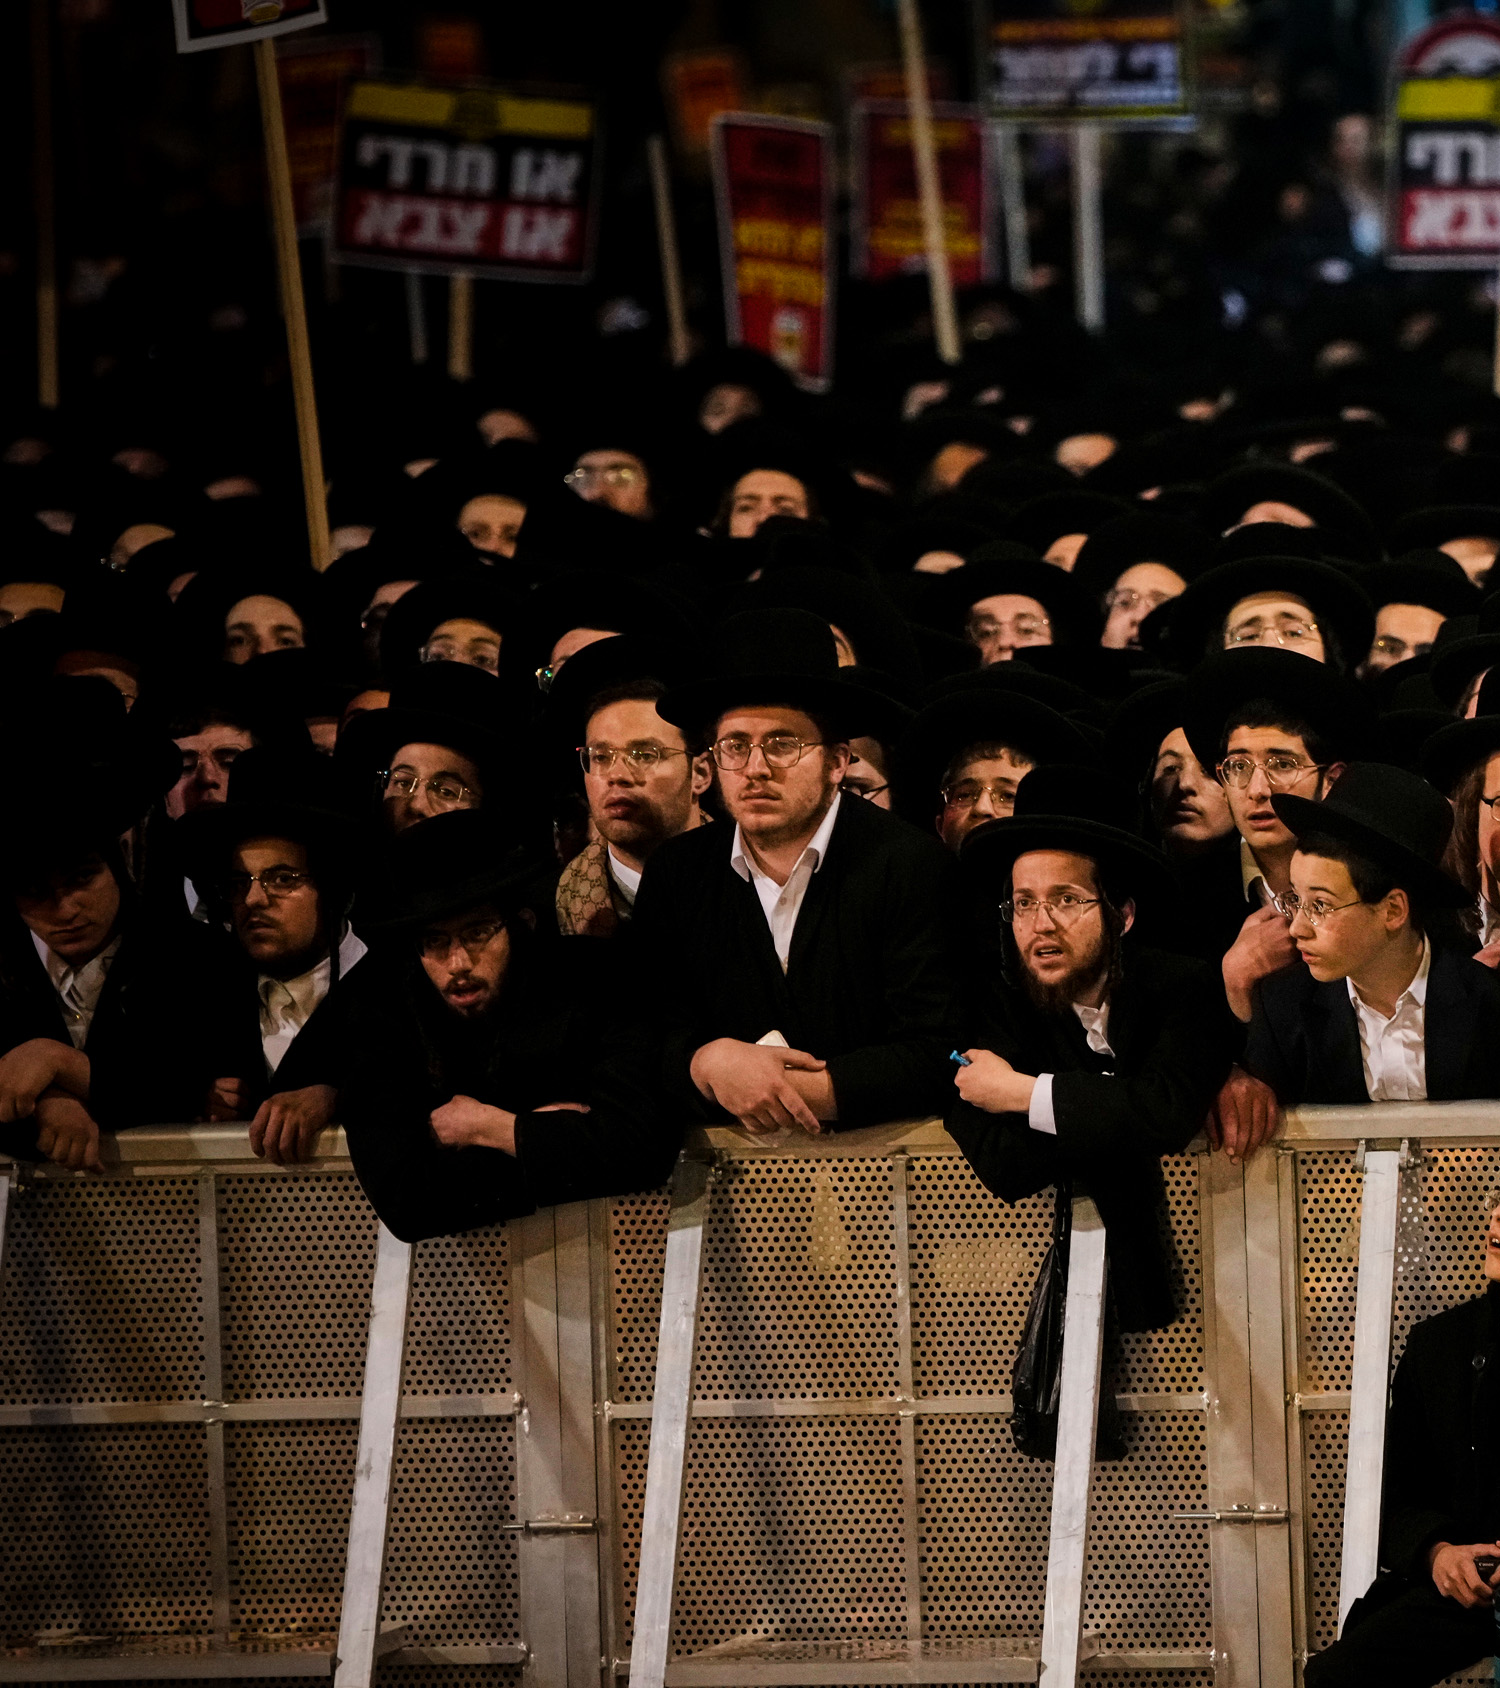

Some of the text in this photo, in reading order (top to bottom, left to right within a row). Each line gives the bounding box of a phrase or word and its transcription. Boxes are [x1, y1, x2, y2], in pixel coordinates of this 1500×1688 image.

[354, 131, 501, 197] חרדי
[508, 145, 585, 203] או
[352, 191, 575, 263] או צבא
